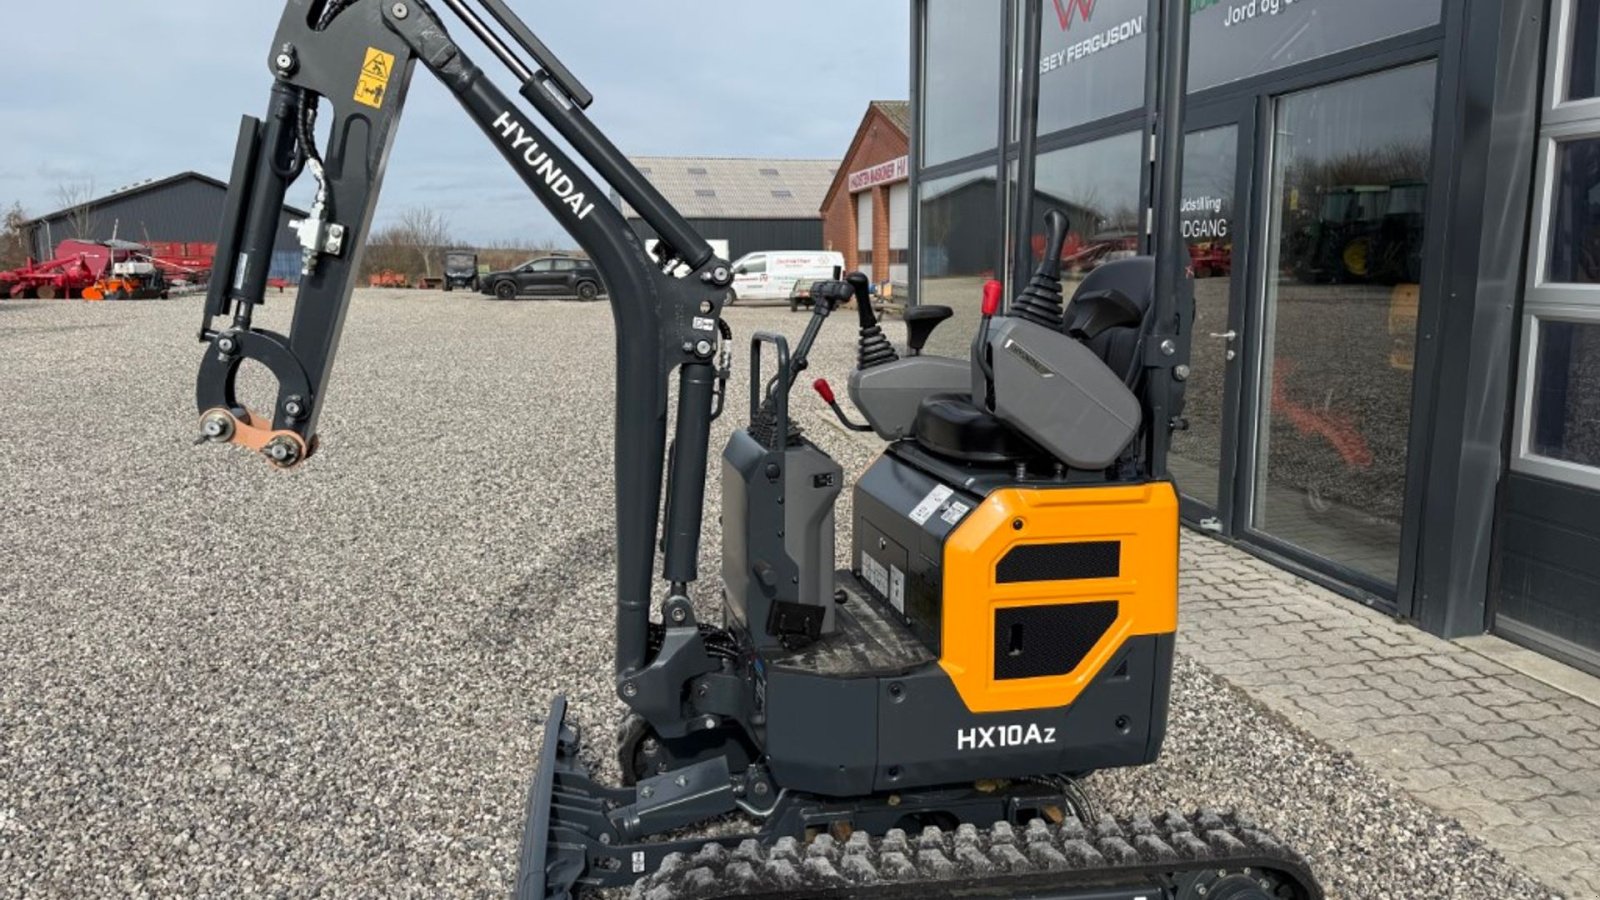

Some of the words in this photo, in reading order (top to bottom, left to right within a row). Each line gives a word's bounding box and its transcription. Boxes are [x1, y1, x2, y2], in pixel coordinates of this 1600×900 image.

[1224, 0, 1256, 27] Jord
[1066, 15, 1142, 63] FERGUSON
[492, 111, 595, 220] HYUNDAI
[1180, 218, 1227, 238] DGANG
